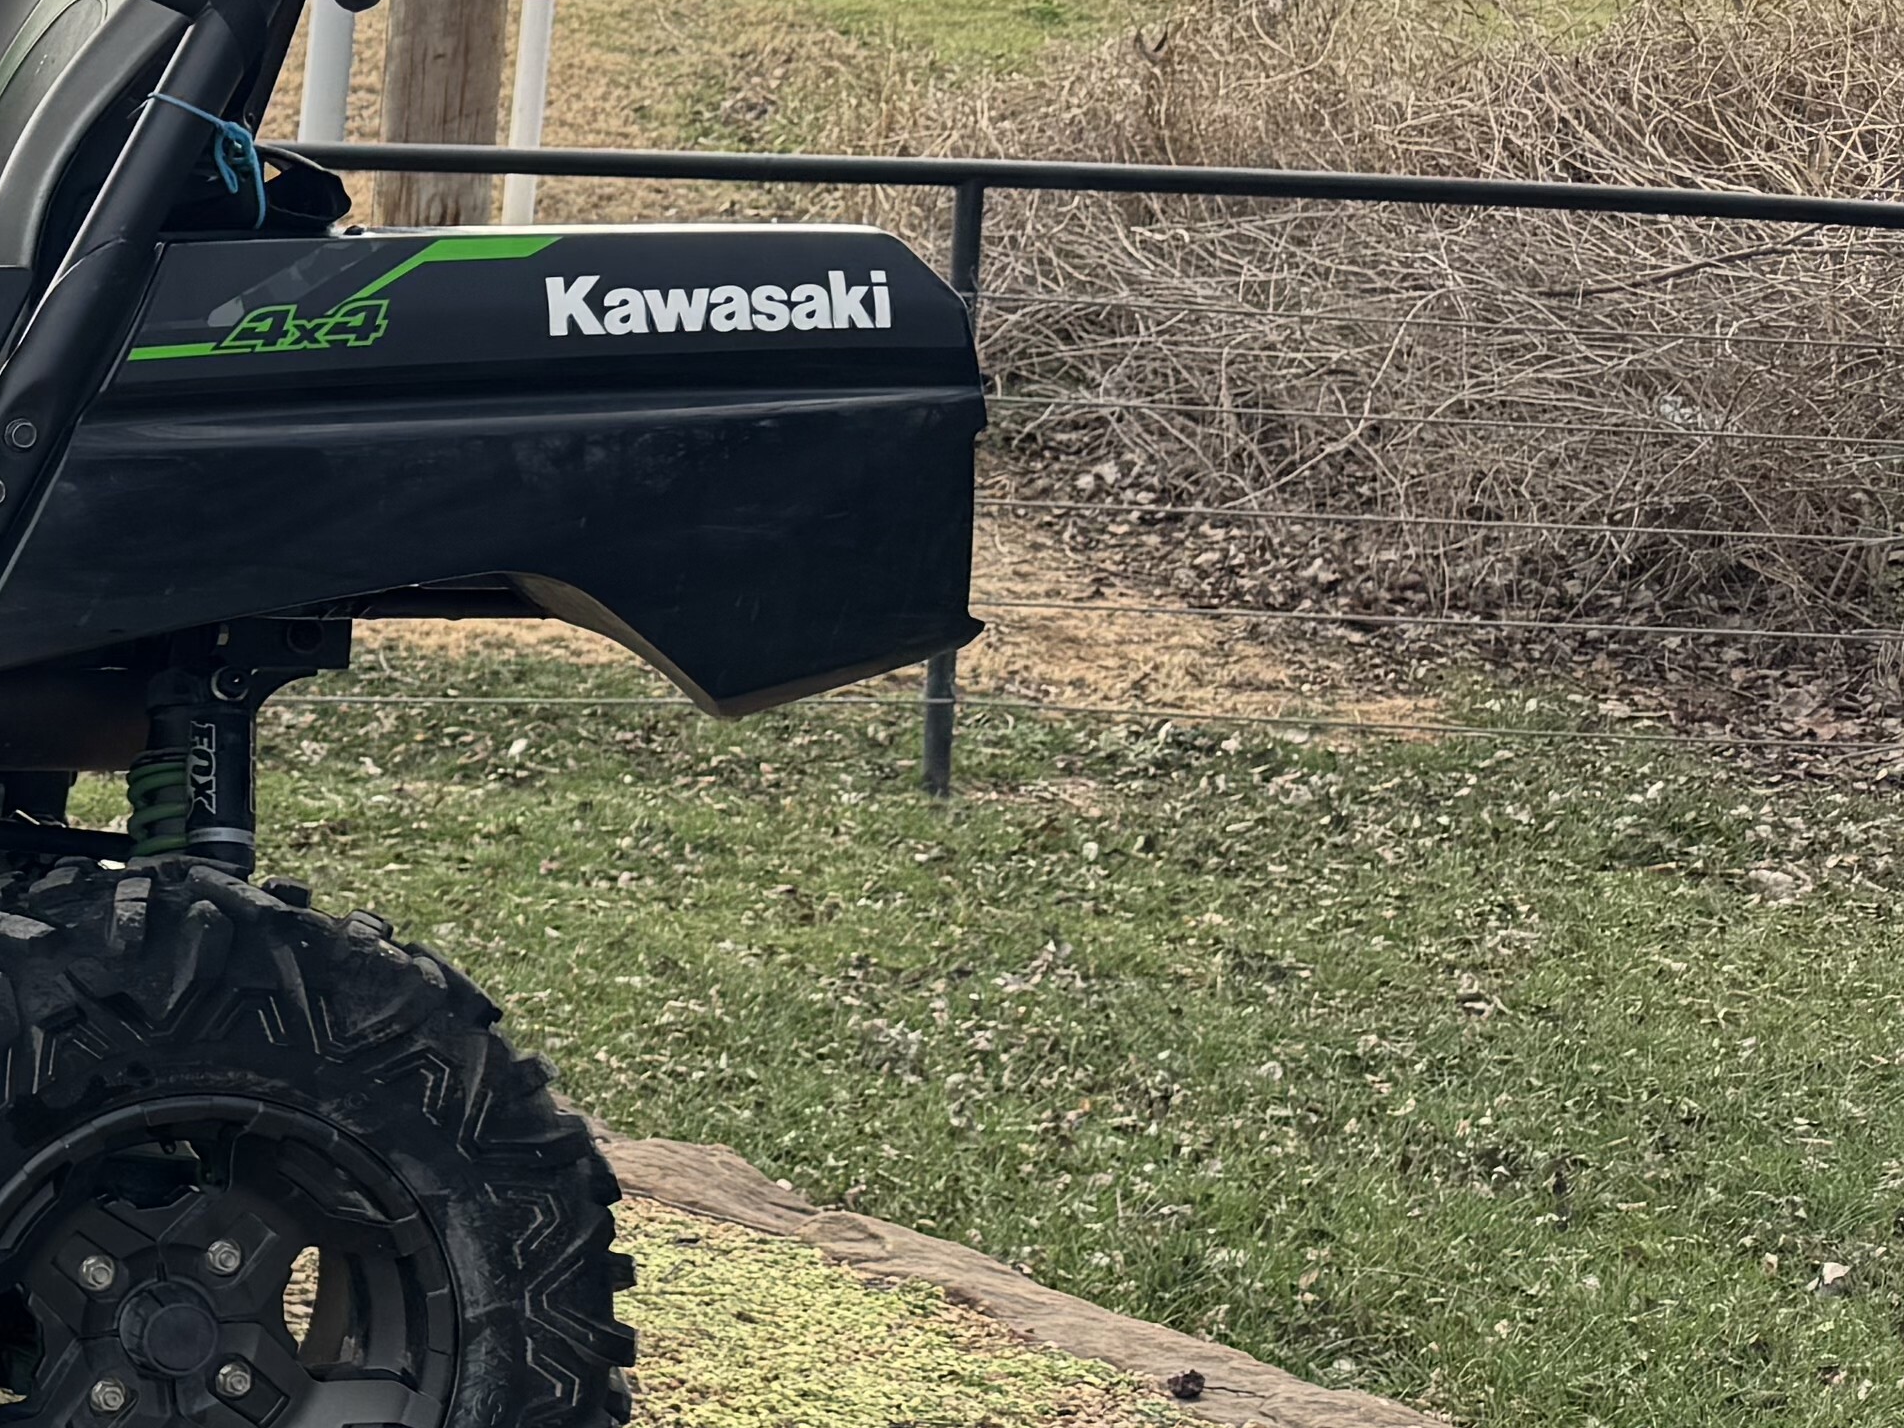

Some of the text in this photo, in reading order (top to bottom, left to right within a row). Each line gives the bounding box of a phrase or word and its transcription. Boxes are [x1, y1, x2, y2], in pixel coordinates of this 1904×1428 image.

[220, 299, 390, 352] 4x4
[545, 269, 892, 337] Kawasaki
[186, 721, 217, 815] FOX
